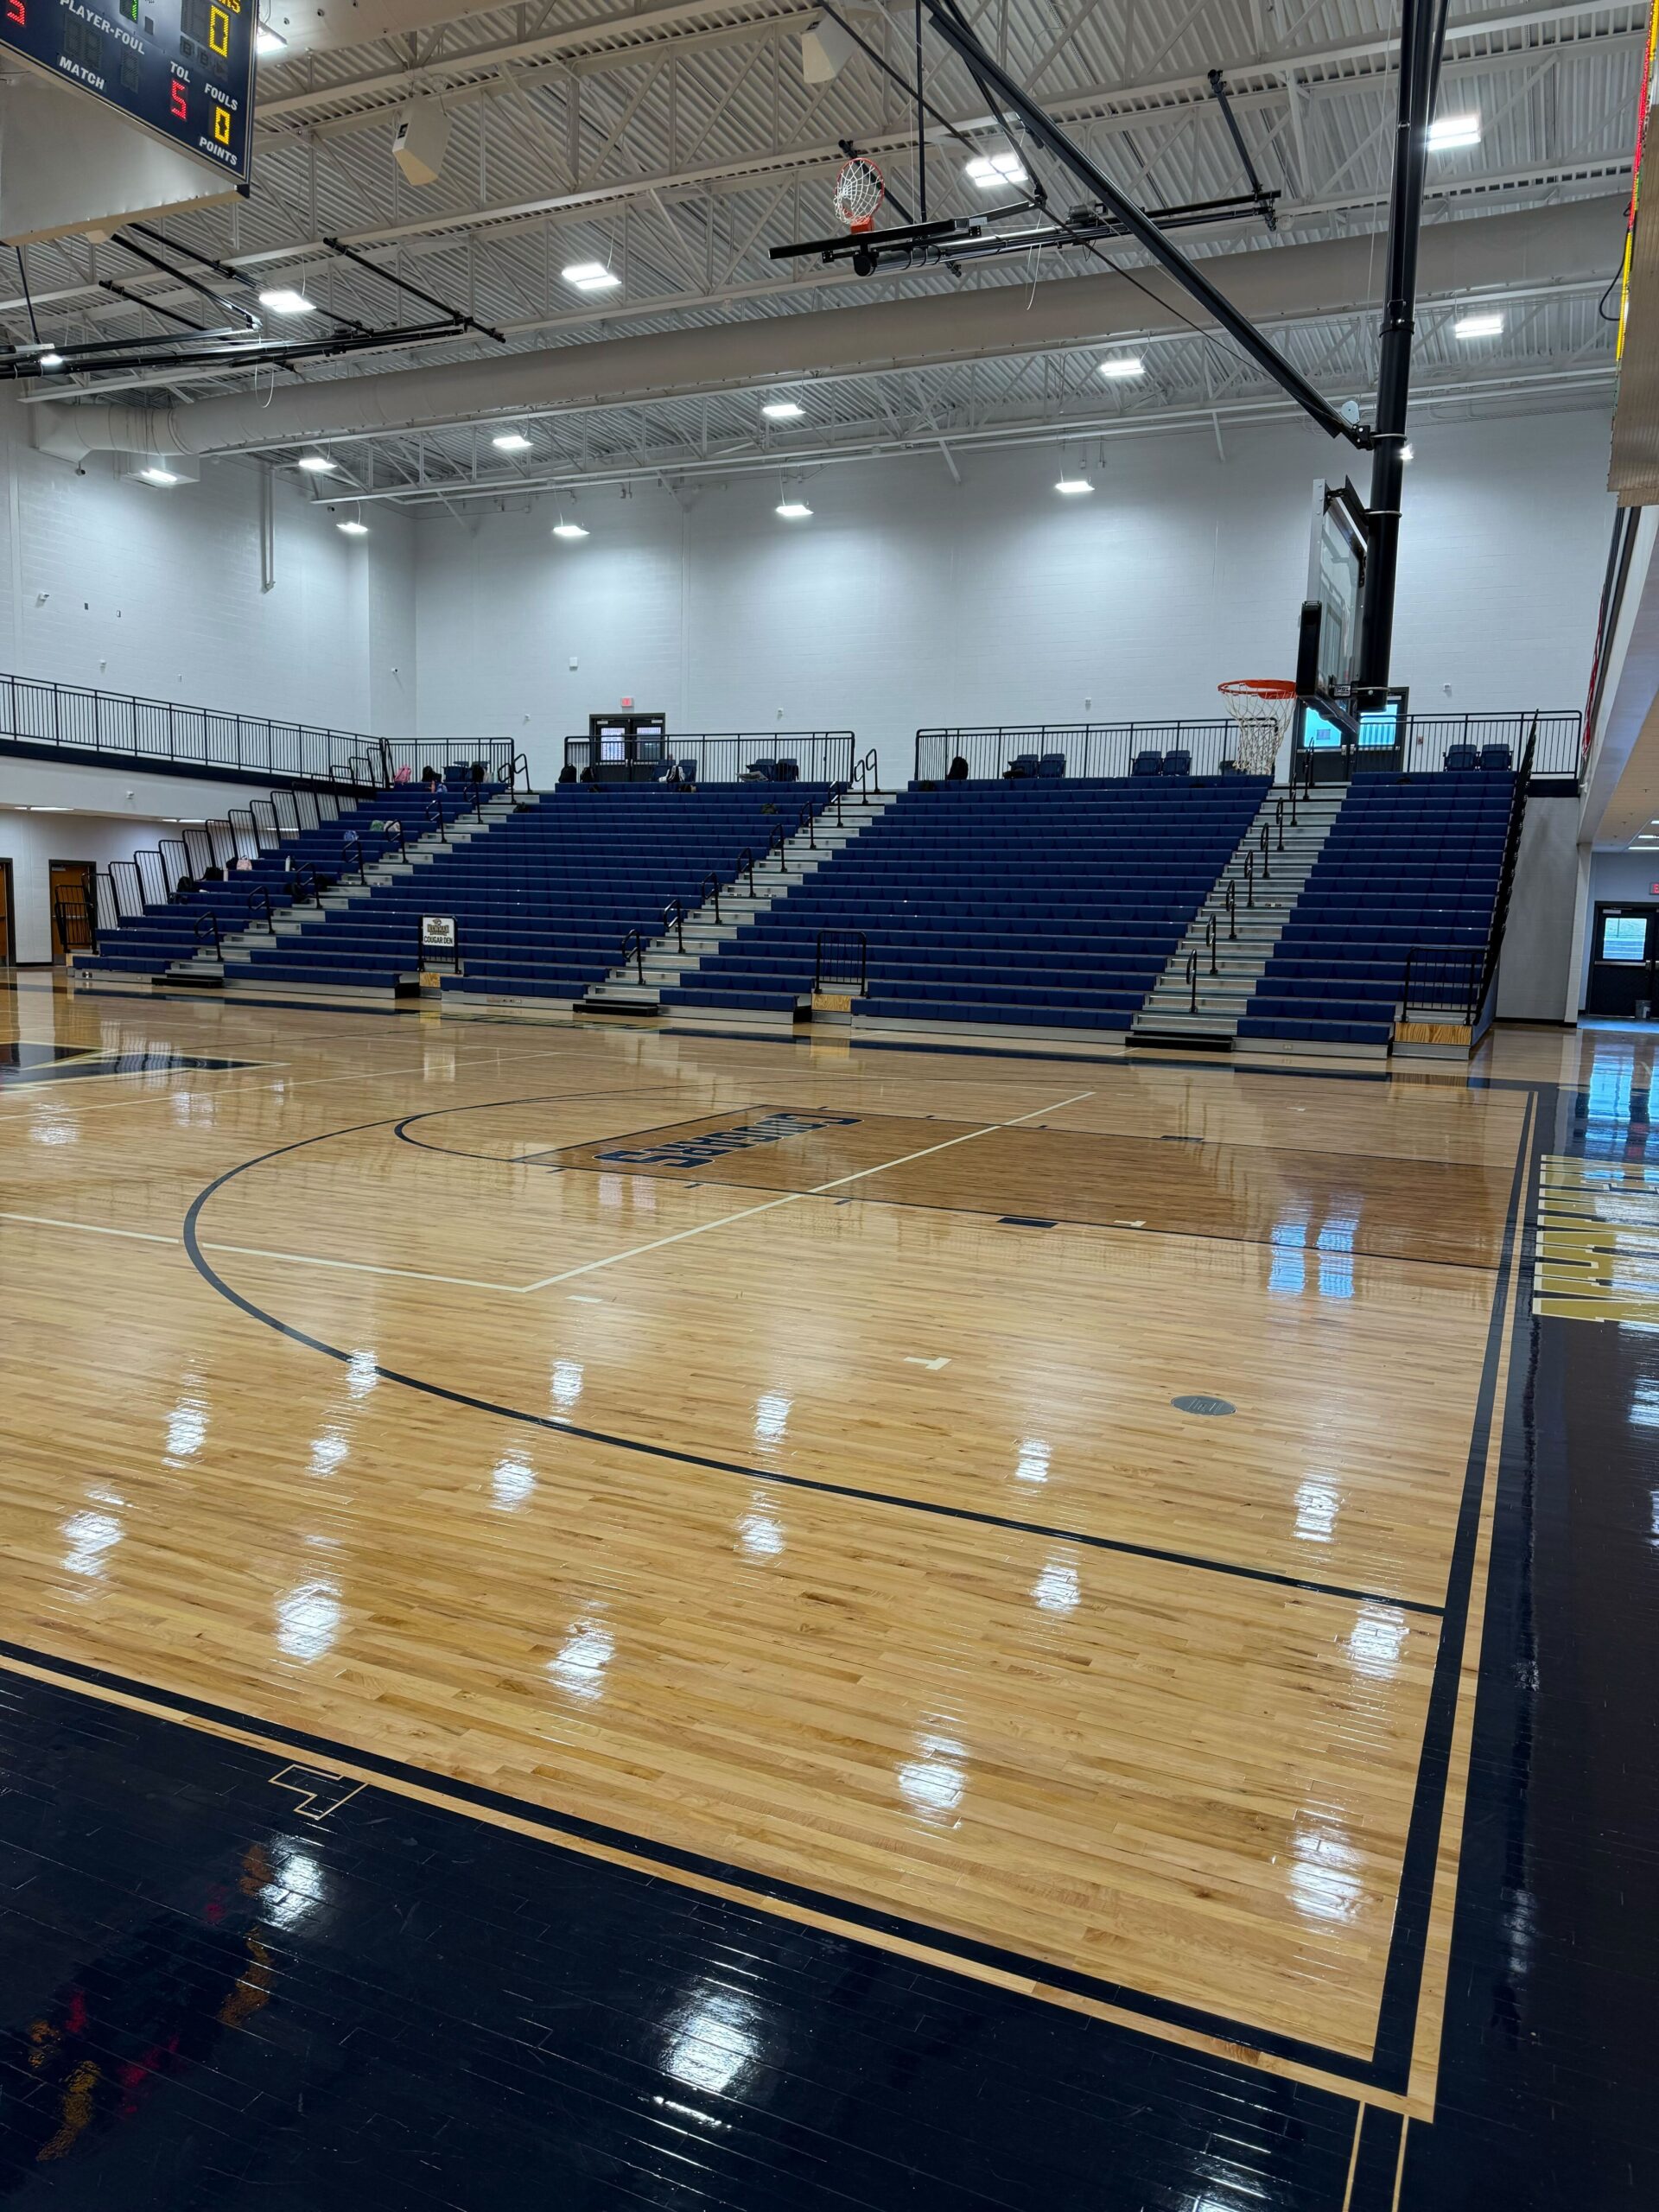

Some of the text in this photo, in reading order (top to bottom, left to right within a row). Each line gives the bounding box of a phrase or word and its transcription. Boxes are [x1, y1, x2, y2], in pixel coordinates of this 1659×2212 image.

[60, 0, 145, 54] PLAYER-FOUL
[59, 56, 105, 90] MATCH
[170, 60, 191, 83] TOL
[171, 79, 187, 120] 5
[205, 83, 238, 111] FOULS
[215, 106, 230, 145] 0
[199, 137, 238, 166] POINTS
[592, 1112, 864, 1168] COUGARS
